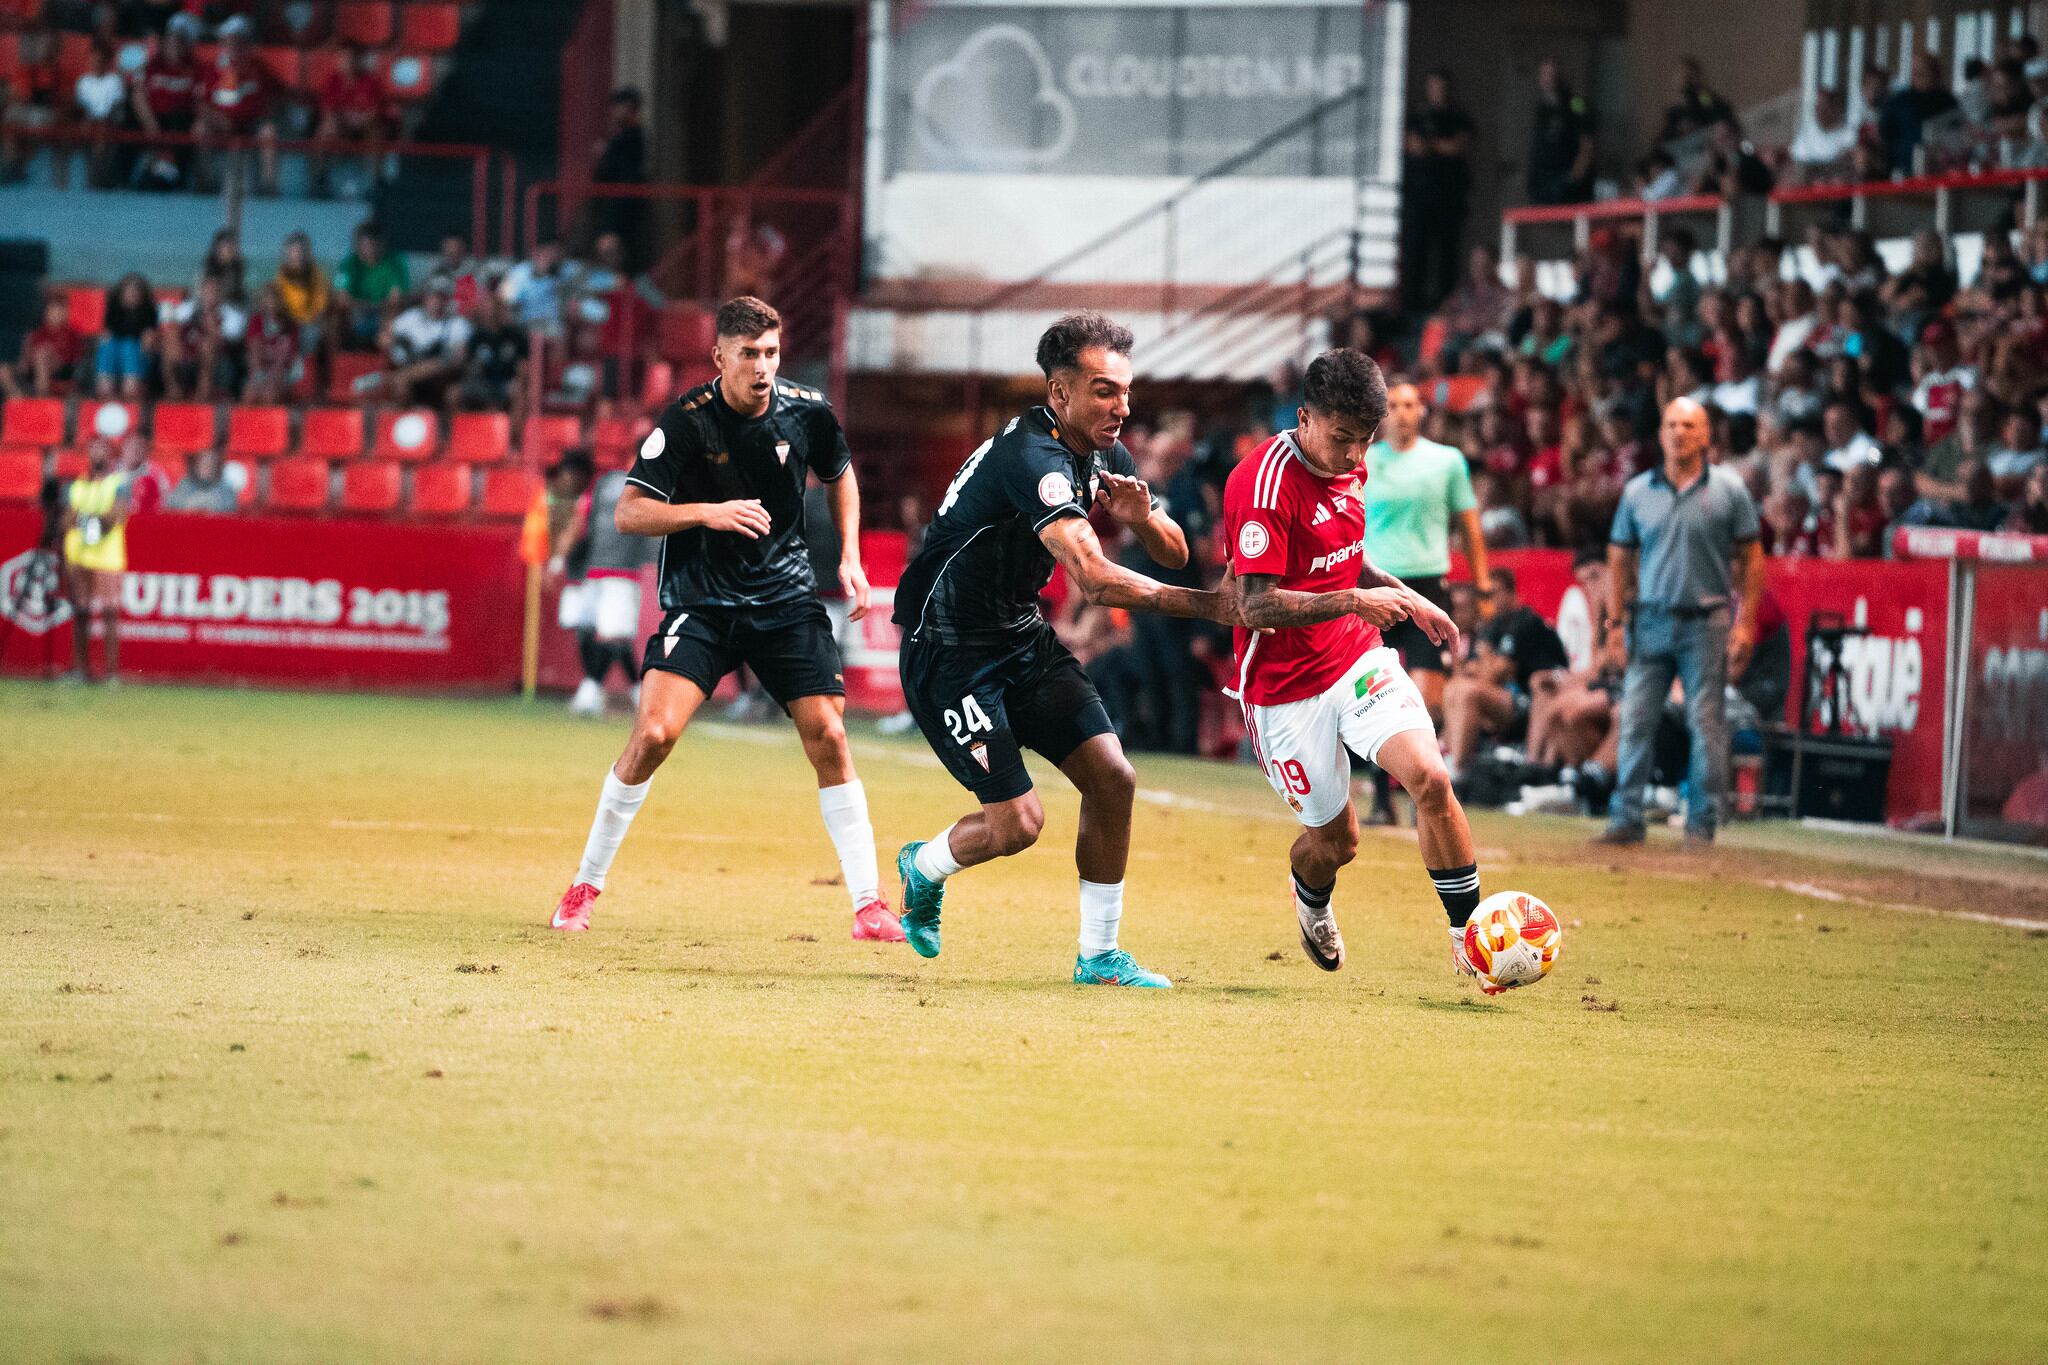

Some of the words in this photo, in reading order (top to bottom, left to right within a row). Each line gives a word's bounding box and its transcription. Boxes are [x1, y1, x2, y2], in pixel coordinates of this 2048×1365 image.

[1326, 537, 1365, 572] parle
[119, 572, 342, 622] UILDERS
[349, 587, 450, 634] 2015
[943, 693, 994, 746] 24
[1354, 698, 1377, 718] Vopak
[1271, 759, 1312, 796] 19
